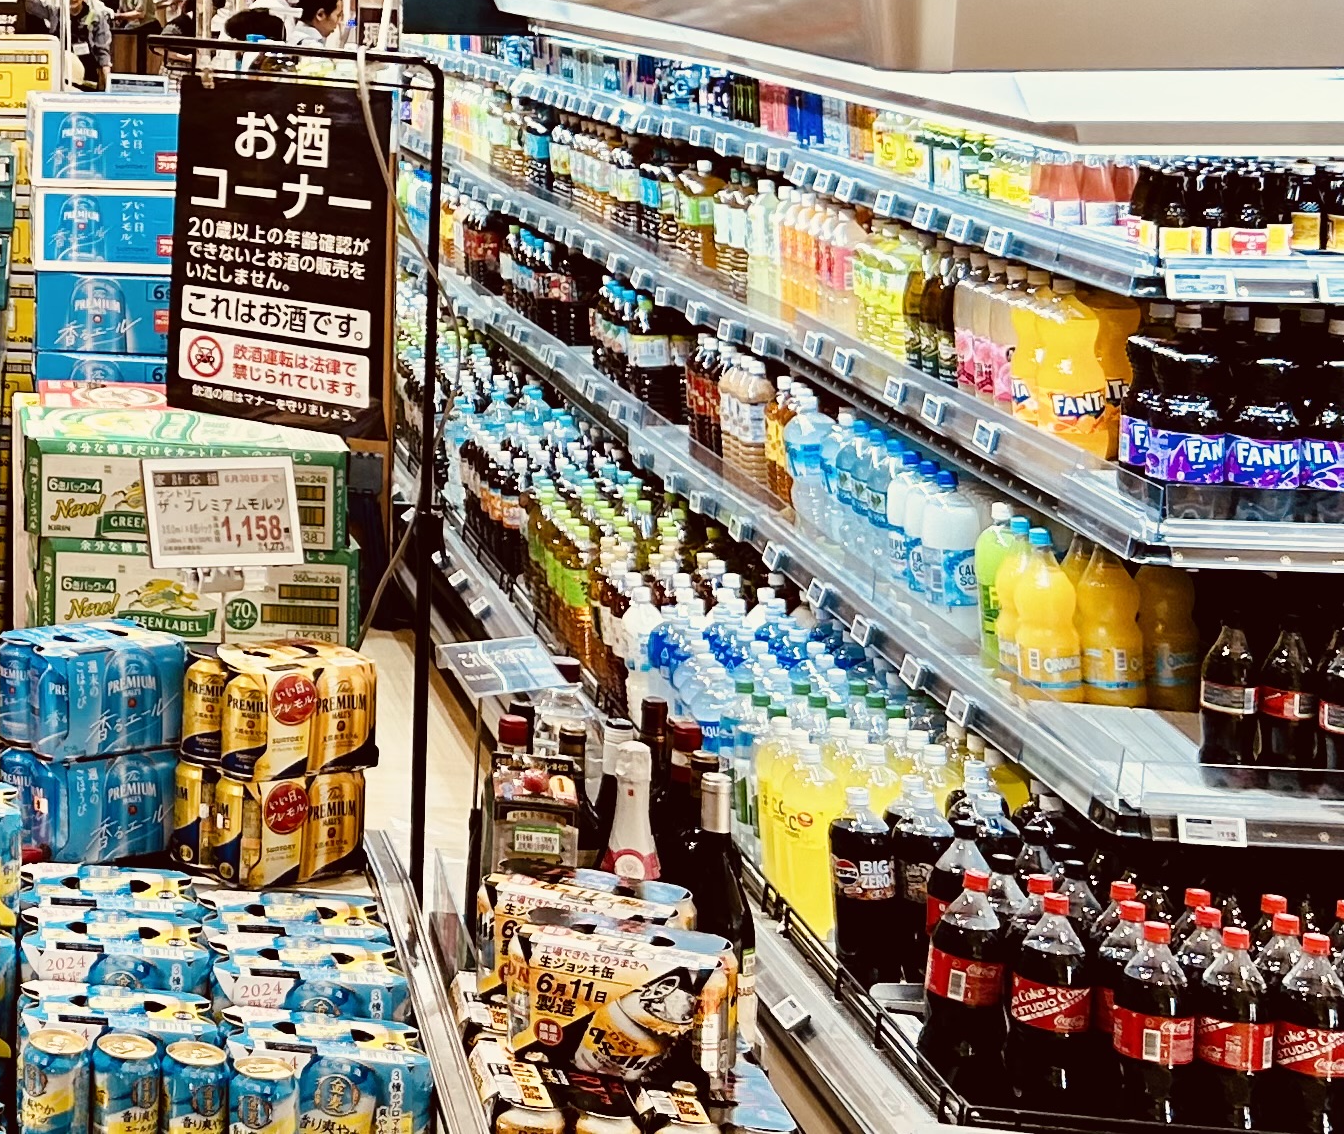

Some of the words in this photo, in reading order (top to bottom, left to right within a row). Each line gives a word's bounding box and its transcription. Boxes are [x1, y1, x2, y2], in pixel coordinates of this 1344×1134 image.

[233, 111, 332, 169] お酒
[190, 165, 372, 220] コーナー
[187, 215, 371, 255] 20歳以上の年齢確認が
[186, 240, 366, 281] できないとお酒の販売を
[185, 263, 291, 293] いたしません。
[187, 290, 365, 342] これはお酒です。
[54, 316, 143, 347] 香るエール
[232, 343, 358, 378] 飲酒運転は法律で
[232, 362, 362, 399] 禁じられています。
[191, 383, 358, 424] 飲酒の際はマナーを守りましょう。
[153, 471, 219, 487] 家計応援
[223, 473, 281, 484] 6月30日まで
[50, 493, 107, 522] New!
[156, 489, 202, 499] サントリー
[156, 497, 286, 514] ザ・プレミアムモルツ
[47, 523, 72, 532] KIRIN
[220, 514, 283, 548] 1,158
[64, 592, 121, 620] New!
[164, 616, 203, 632] LABEL
[107, 674, 157, 696] PREMIUM
[85, 692, 180, 744] 香るエール
[315, 693, 367, 717] PREMIUM
[107, 781, 157, 803] PREMIUM
[308, 799, 356, 822] PREMIUM
[85, 802, 175, 851] 香るエール
[859, 859, 890, 874] BIG
[860, 874, 891, 890] ZERO
[540, 955, 616, 981] 生ジョッキ缶
[541, 943, 650, 973] 工場できたてのうまさへ
[239, 983, 284, 999] 2024
[535, 972, 609, 1005] 6月11日
[1017, 987, 1047, 1005] Coke
[535, 996, 576, 1018] 製造
